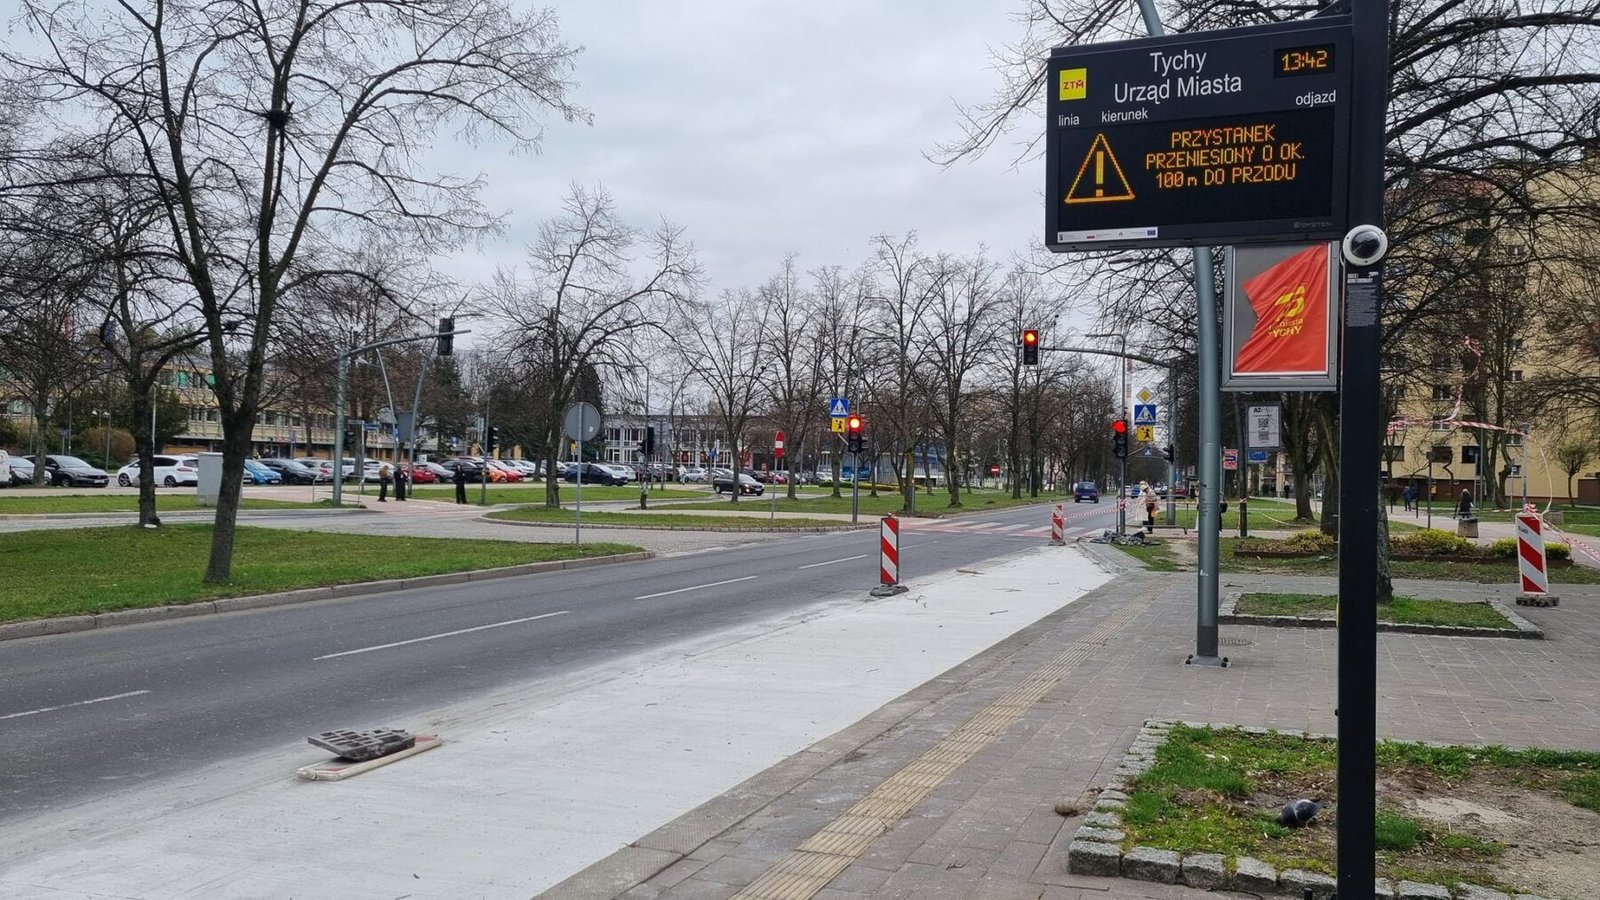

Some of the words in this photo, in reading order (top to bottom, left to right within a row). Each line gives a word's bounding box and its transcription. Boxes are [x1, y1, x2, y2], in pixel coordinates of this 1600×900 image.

[1149, 49, 1207, 78] Tychy
[1282, 50, 1328, 71] 13:42
[1114, 79, 1170, 104] Urząd
[1178, 73, 1242, 98] Miasta
[1295, 89, 1337, 107] odjazd
[1058, 114, 1080, 127] linia
[1101, 107, 1149, 123] kierunek
[1171, 124, 1276, 149] PRZYSTANEK
[1146, 145, 1255, 170] PRZENIESIONY
[1262, 144, 1273, 162] O
[1280, 142, 1306, 161] OK.
[1156, 171, 1184, 189] 100
[1187, 175, 1198, 187] m
[1204, 168, 1225, 186] DO
[1232, 163, 1296, 184] PRZODU
